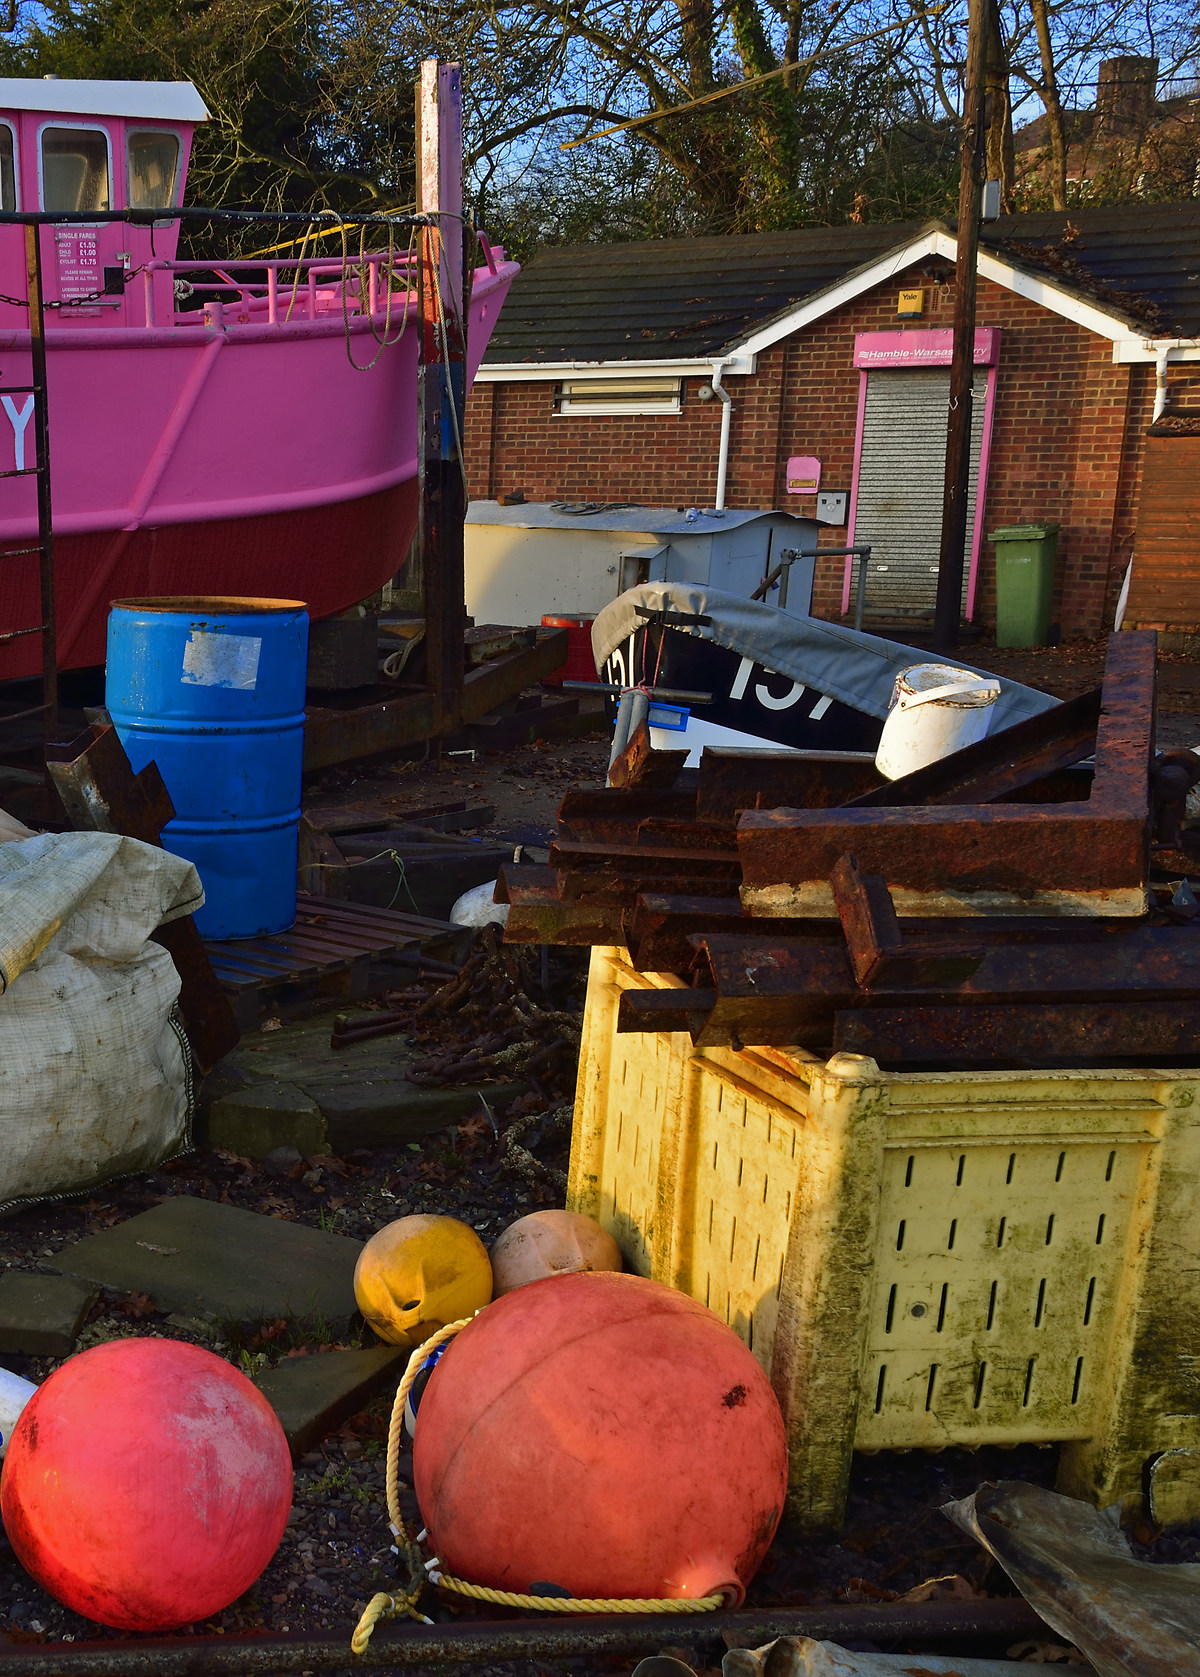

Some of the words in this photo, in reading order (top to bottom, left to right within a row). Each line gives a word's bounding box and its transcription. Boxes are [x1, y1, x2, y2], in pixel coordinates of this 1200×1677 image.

[902, 293, 918, 301] Yale
[868, 347, 954, 359] Hamble-Warsas
[973, 347, 988, 356] rry
